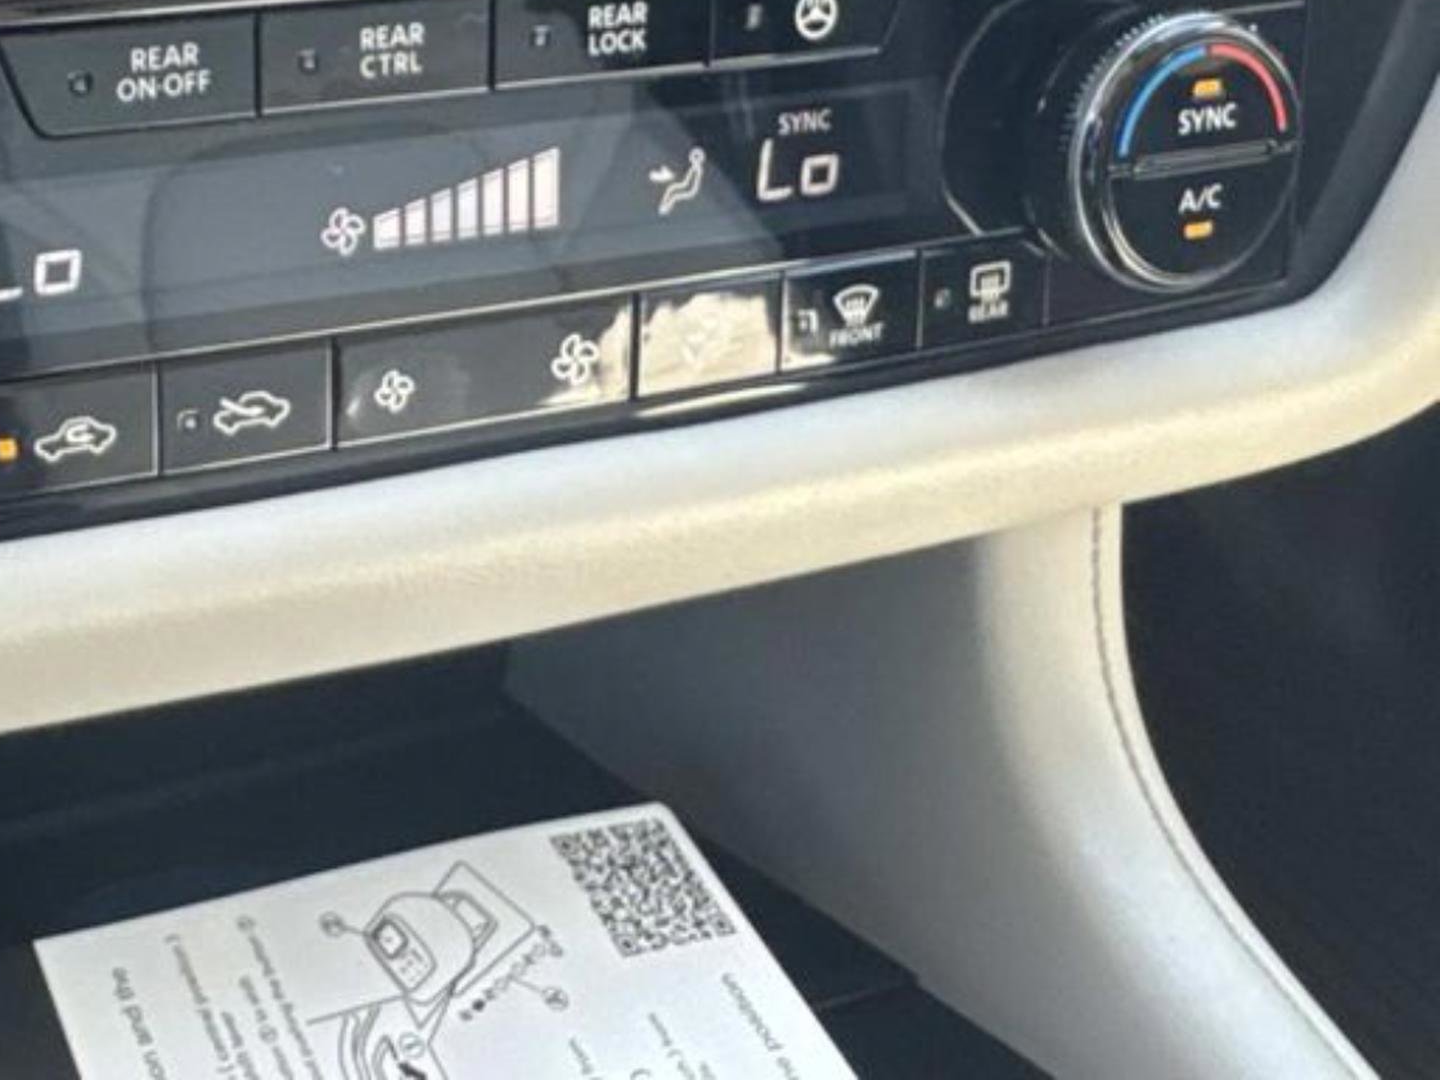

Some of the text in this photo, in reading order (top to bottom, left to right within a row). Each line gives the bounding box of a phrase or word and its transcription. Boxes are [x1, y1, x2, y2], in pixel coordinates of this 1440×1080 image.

[587, 0, 649, 29] REAR
[360, 21, 424, 50] REAR
[587, 28, 648, 57] LOCK
[130, 42, 200, 71] REAR
[360, 52, 422, 79] CTRL
[777, 107, 833, 137] SYNC
[1177, 102, 1239, 136] SYNC
[1177, 182, 1223, 214] A/C
